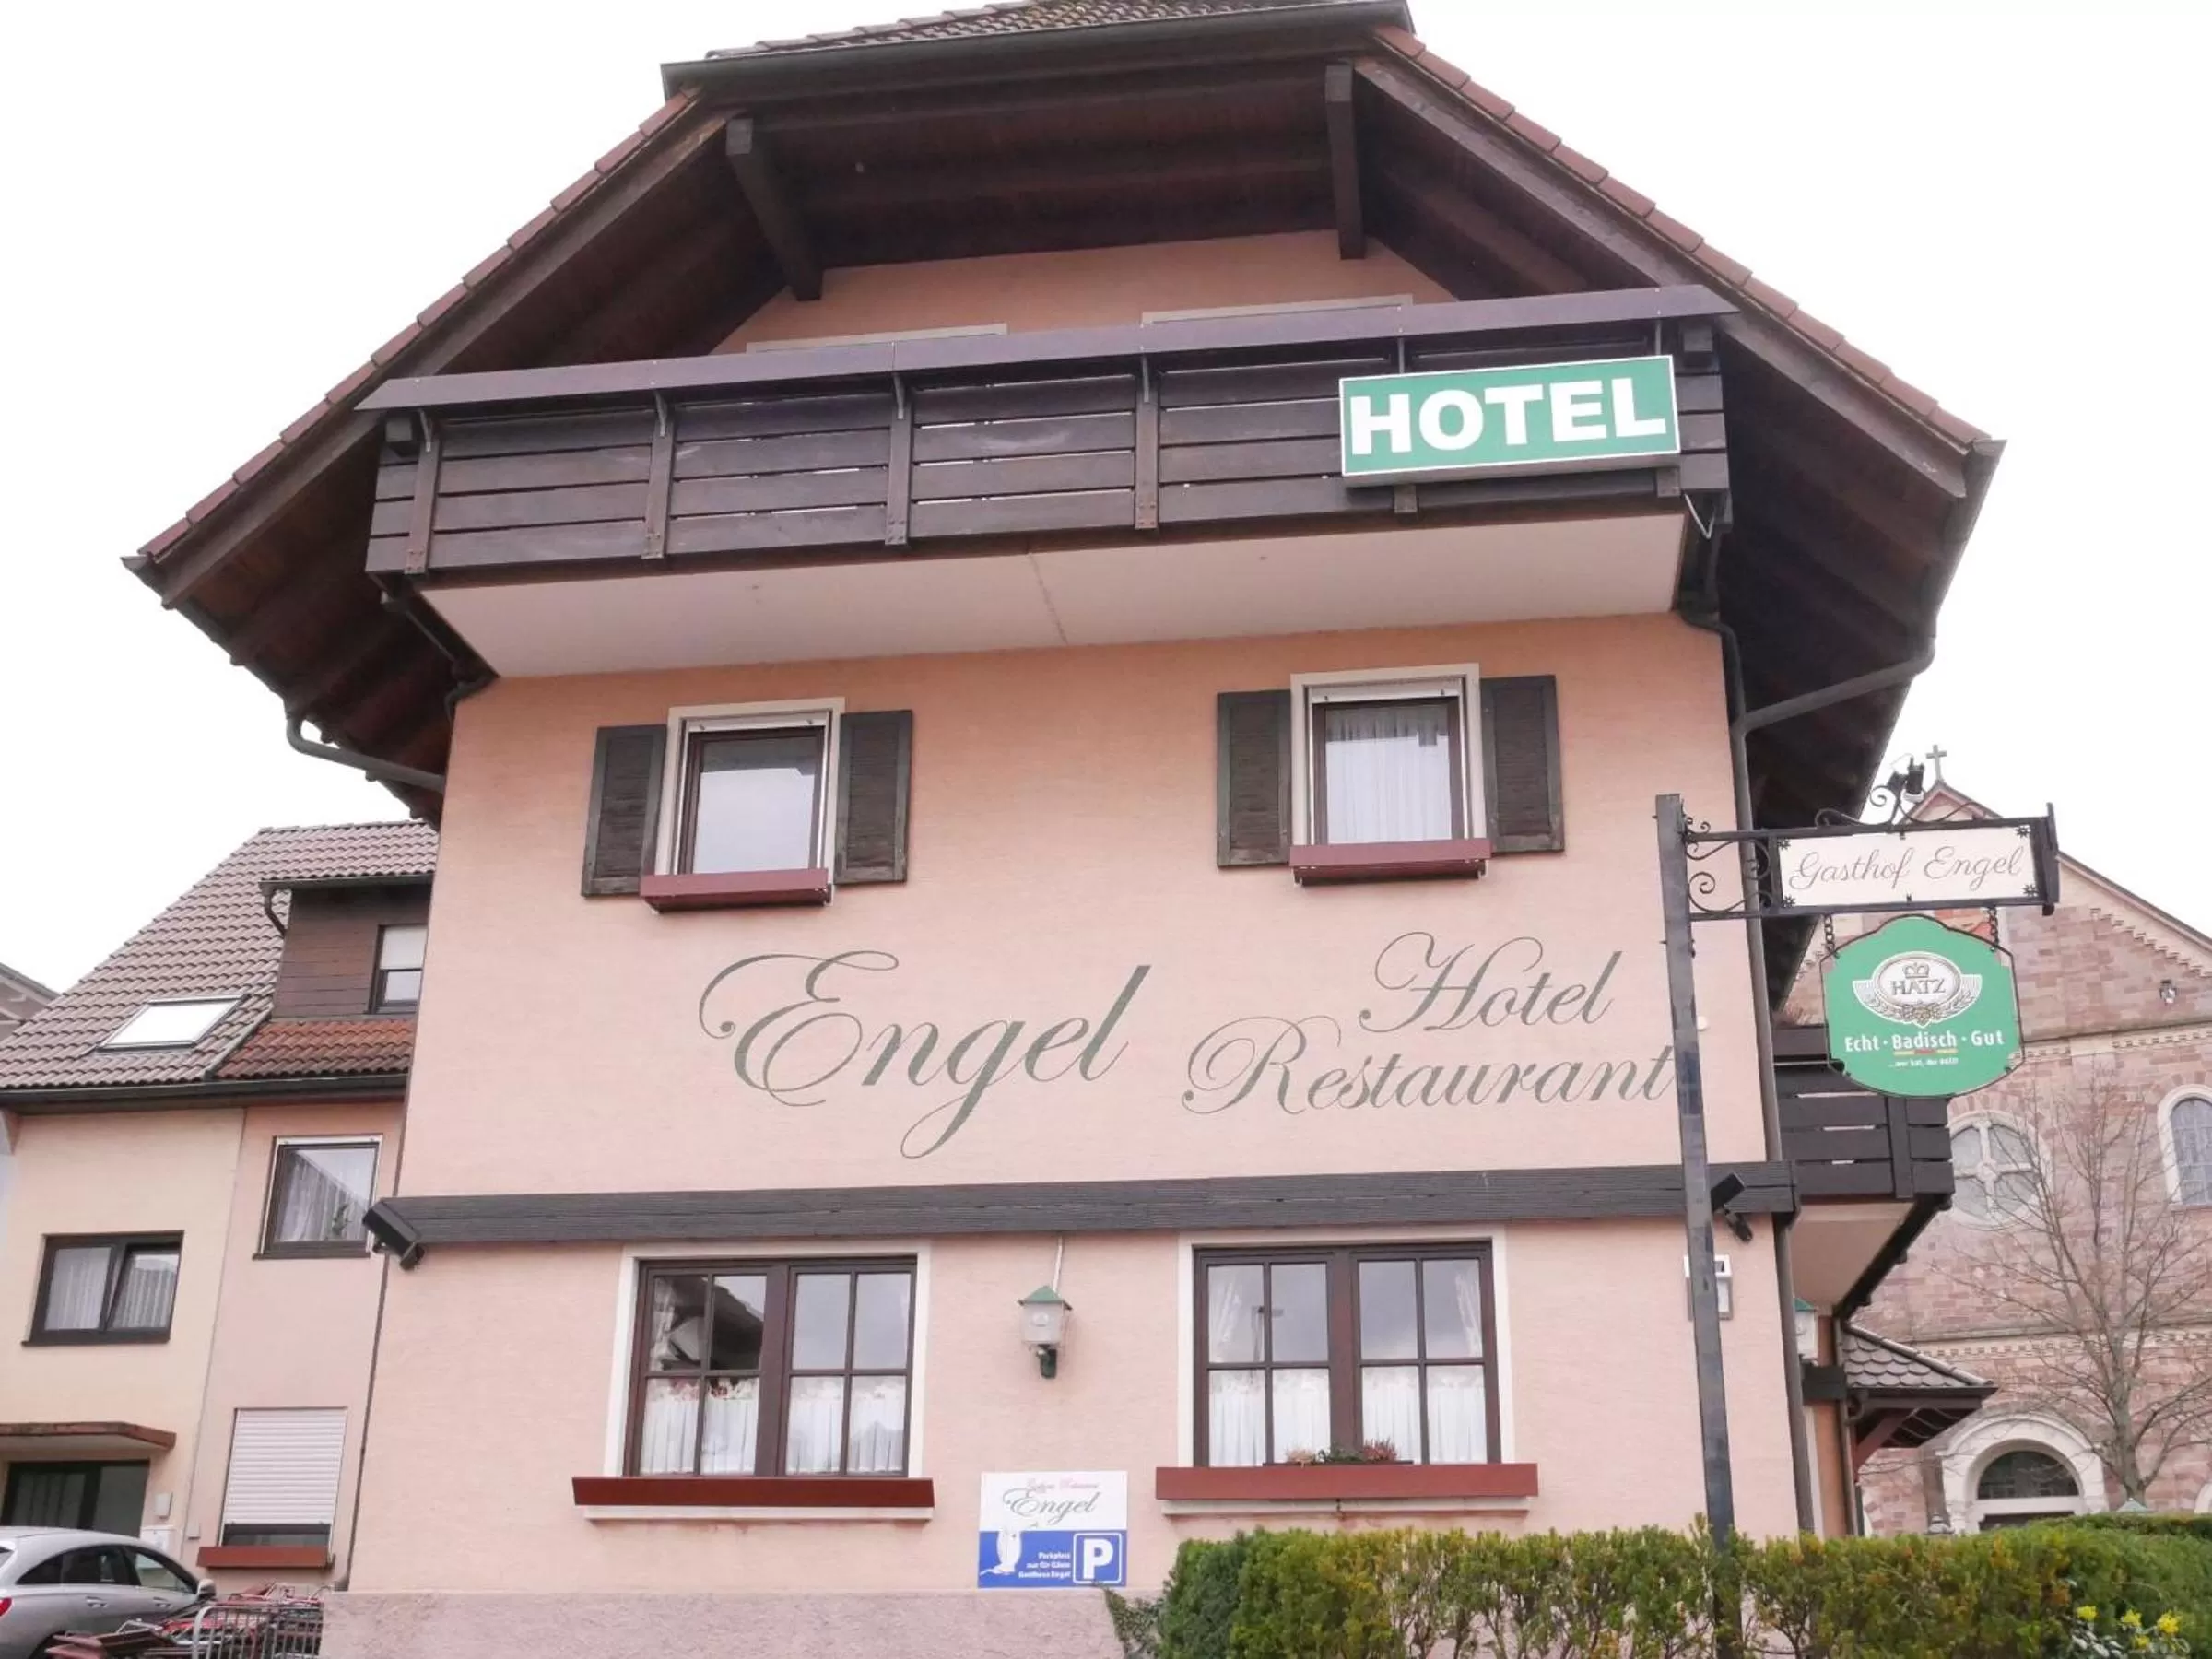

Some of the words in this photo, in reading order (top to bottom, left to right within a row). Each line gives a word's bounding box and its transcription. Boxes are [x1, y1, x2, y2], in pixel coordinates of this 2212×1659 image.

[1350, 377, 1667, 455] HOTEL
[1789, 846, 1914, 890] Gasthof
[1924, 845, 2024, 892] Engel
[1359, 931, 1622, 1033] Hotel
[1890, 978, 1947, 996] HATZ
[699, 950, 1152, 1159] Engel
[1844, 1034, 1880, 1053] Echt
[1891, 1030, 1958, 1050] Badisch
[1971, 1029, 2005, 1047] Gut
[1181, 1015, 1675, 1115] Restaurant
[1003, 1488, 1100, 1525] Engel
[1083, 1539, 1113, 1579] P
